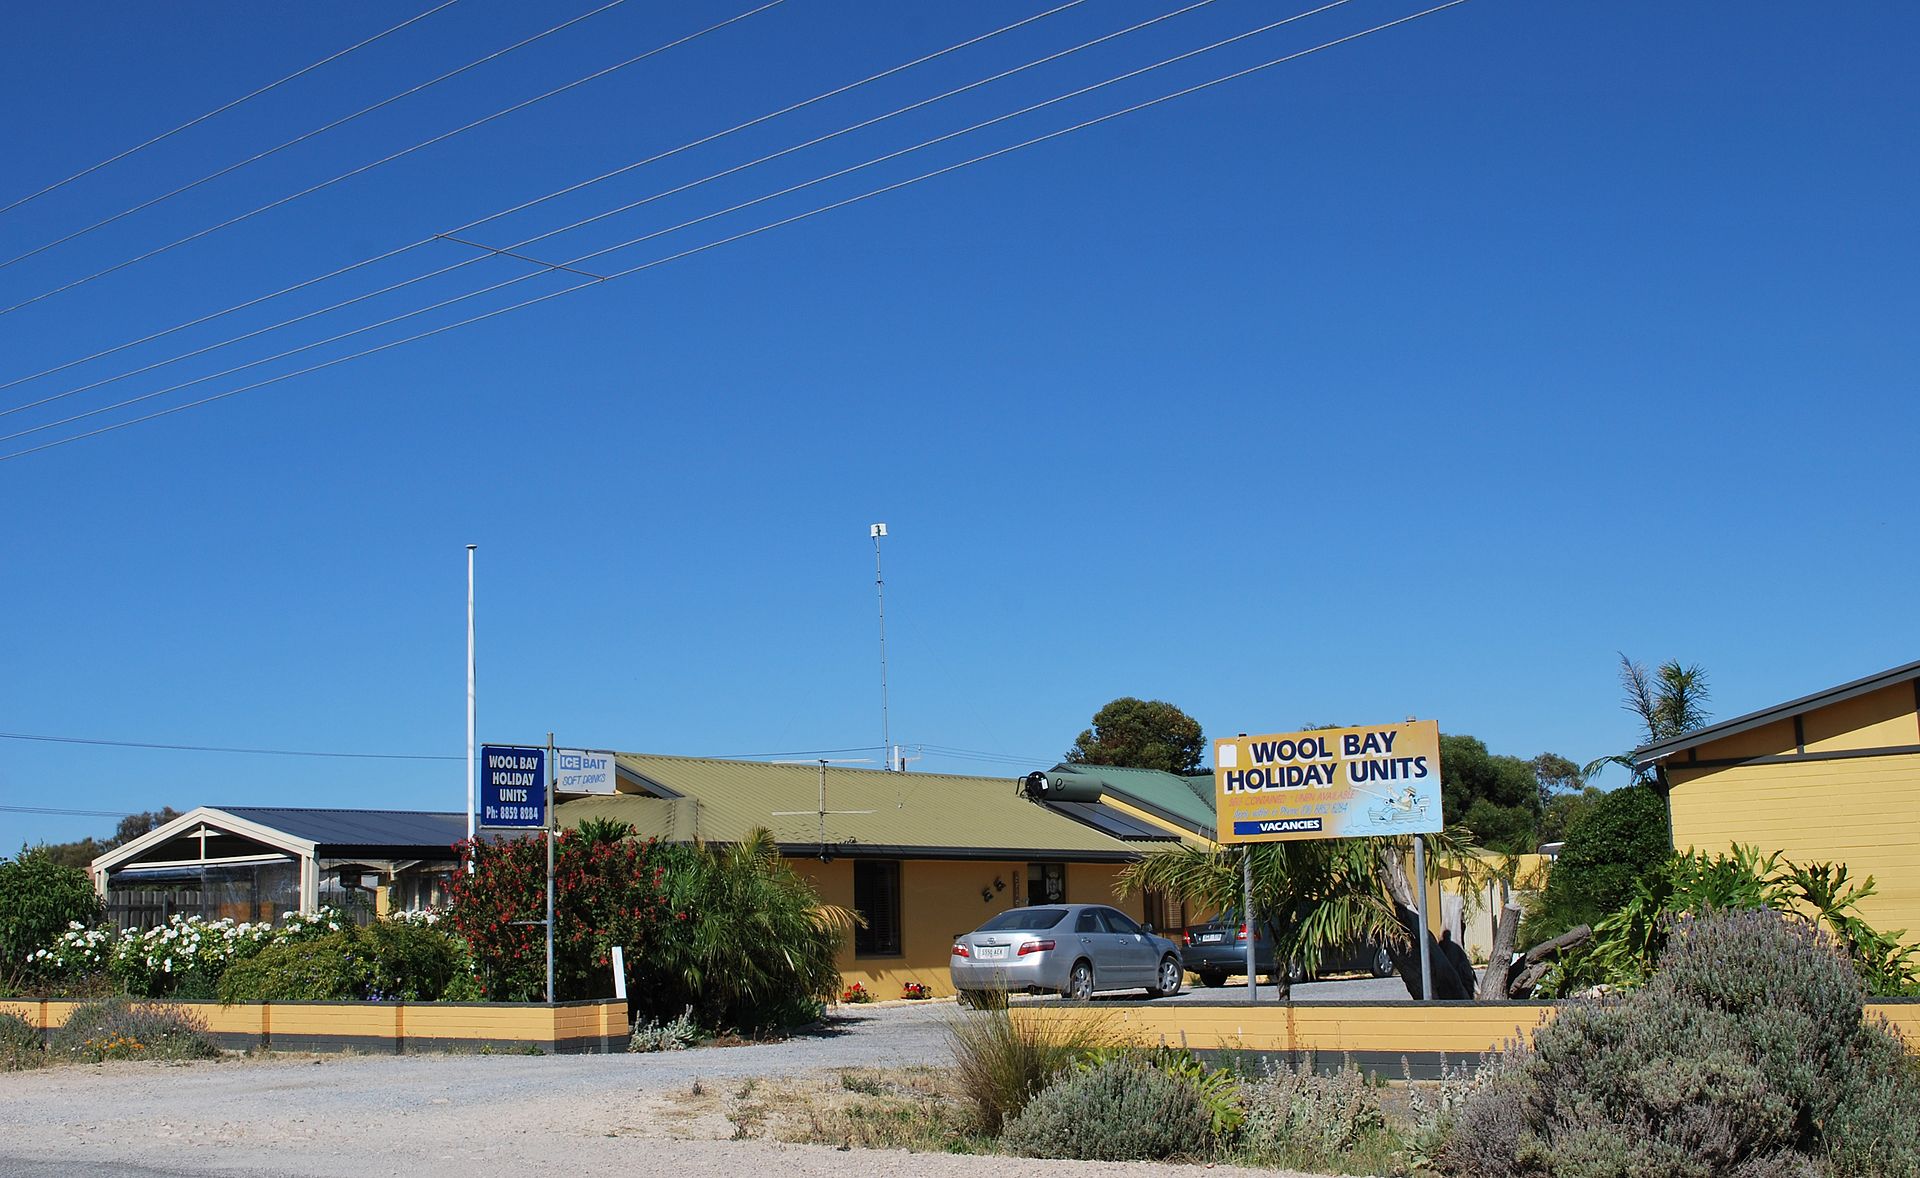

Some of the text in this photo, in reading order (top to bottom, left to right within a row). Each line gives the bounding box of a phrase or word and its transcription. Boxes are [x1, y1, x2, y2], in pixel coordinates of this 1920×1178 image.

[1251, 730, 1397, 764] WOOL BAY
[489, 755, 539, 770] WOOL BAY
[561, 756, 607, 770] ICE BAIT
[492, 772, 535, 786] HOLIDAY
[562, 773, 606, 786] SOFT DRINKS
[1225, 756, 1428, 792] HOLIDAY UNITS
[499, 788, 528, 802] UNITS
[486, 806, 498, 819] Ph:
[1260, 820, 1320, 832] VACANCIES
